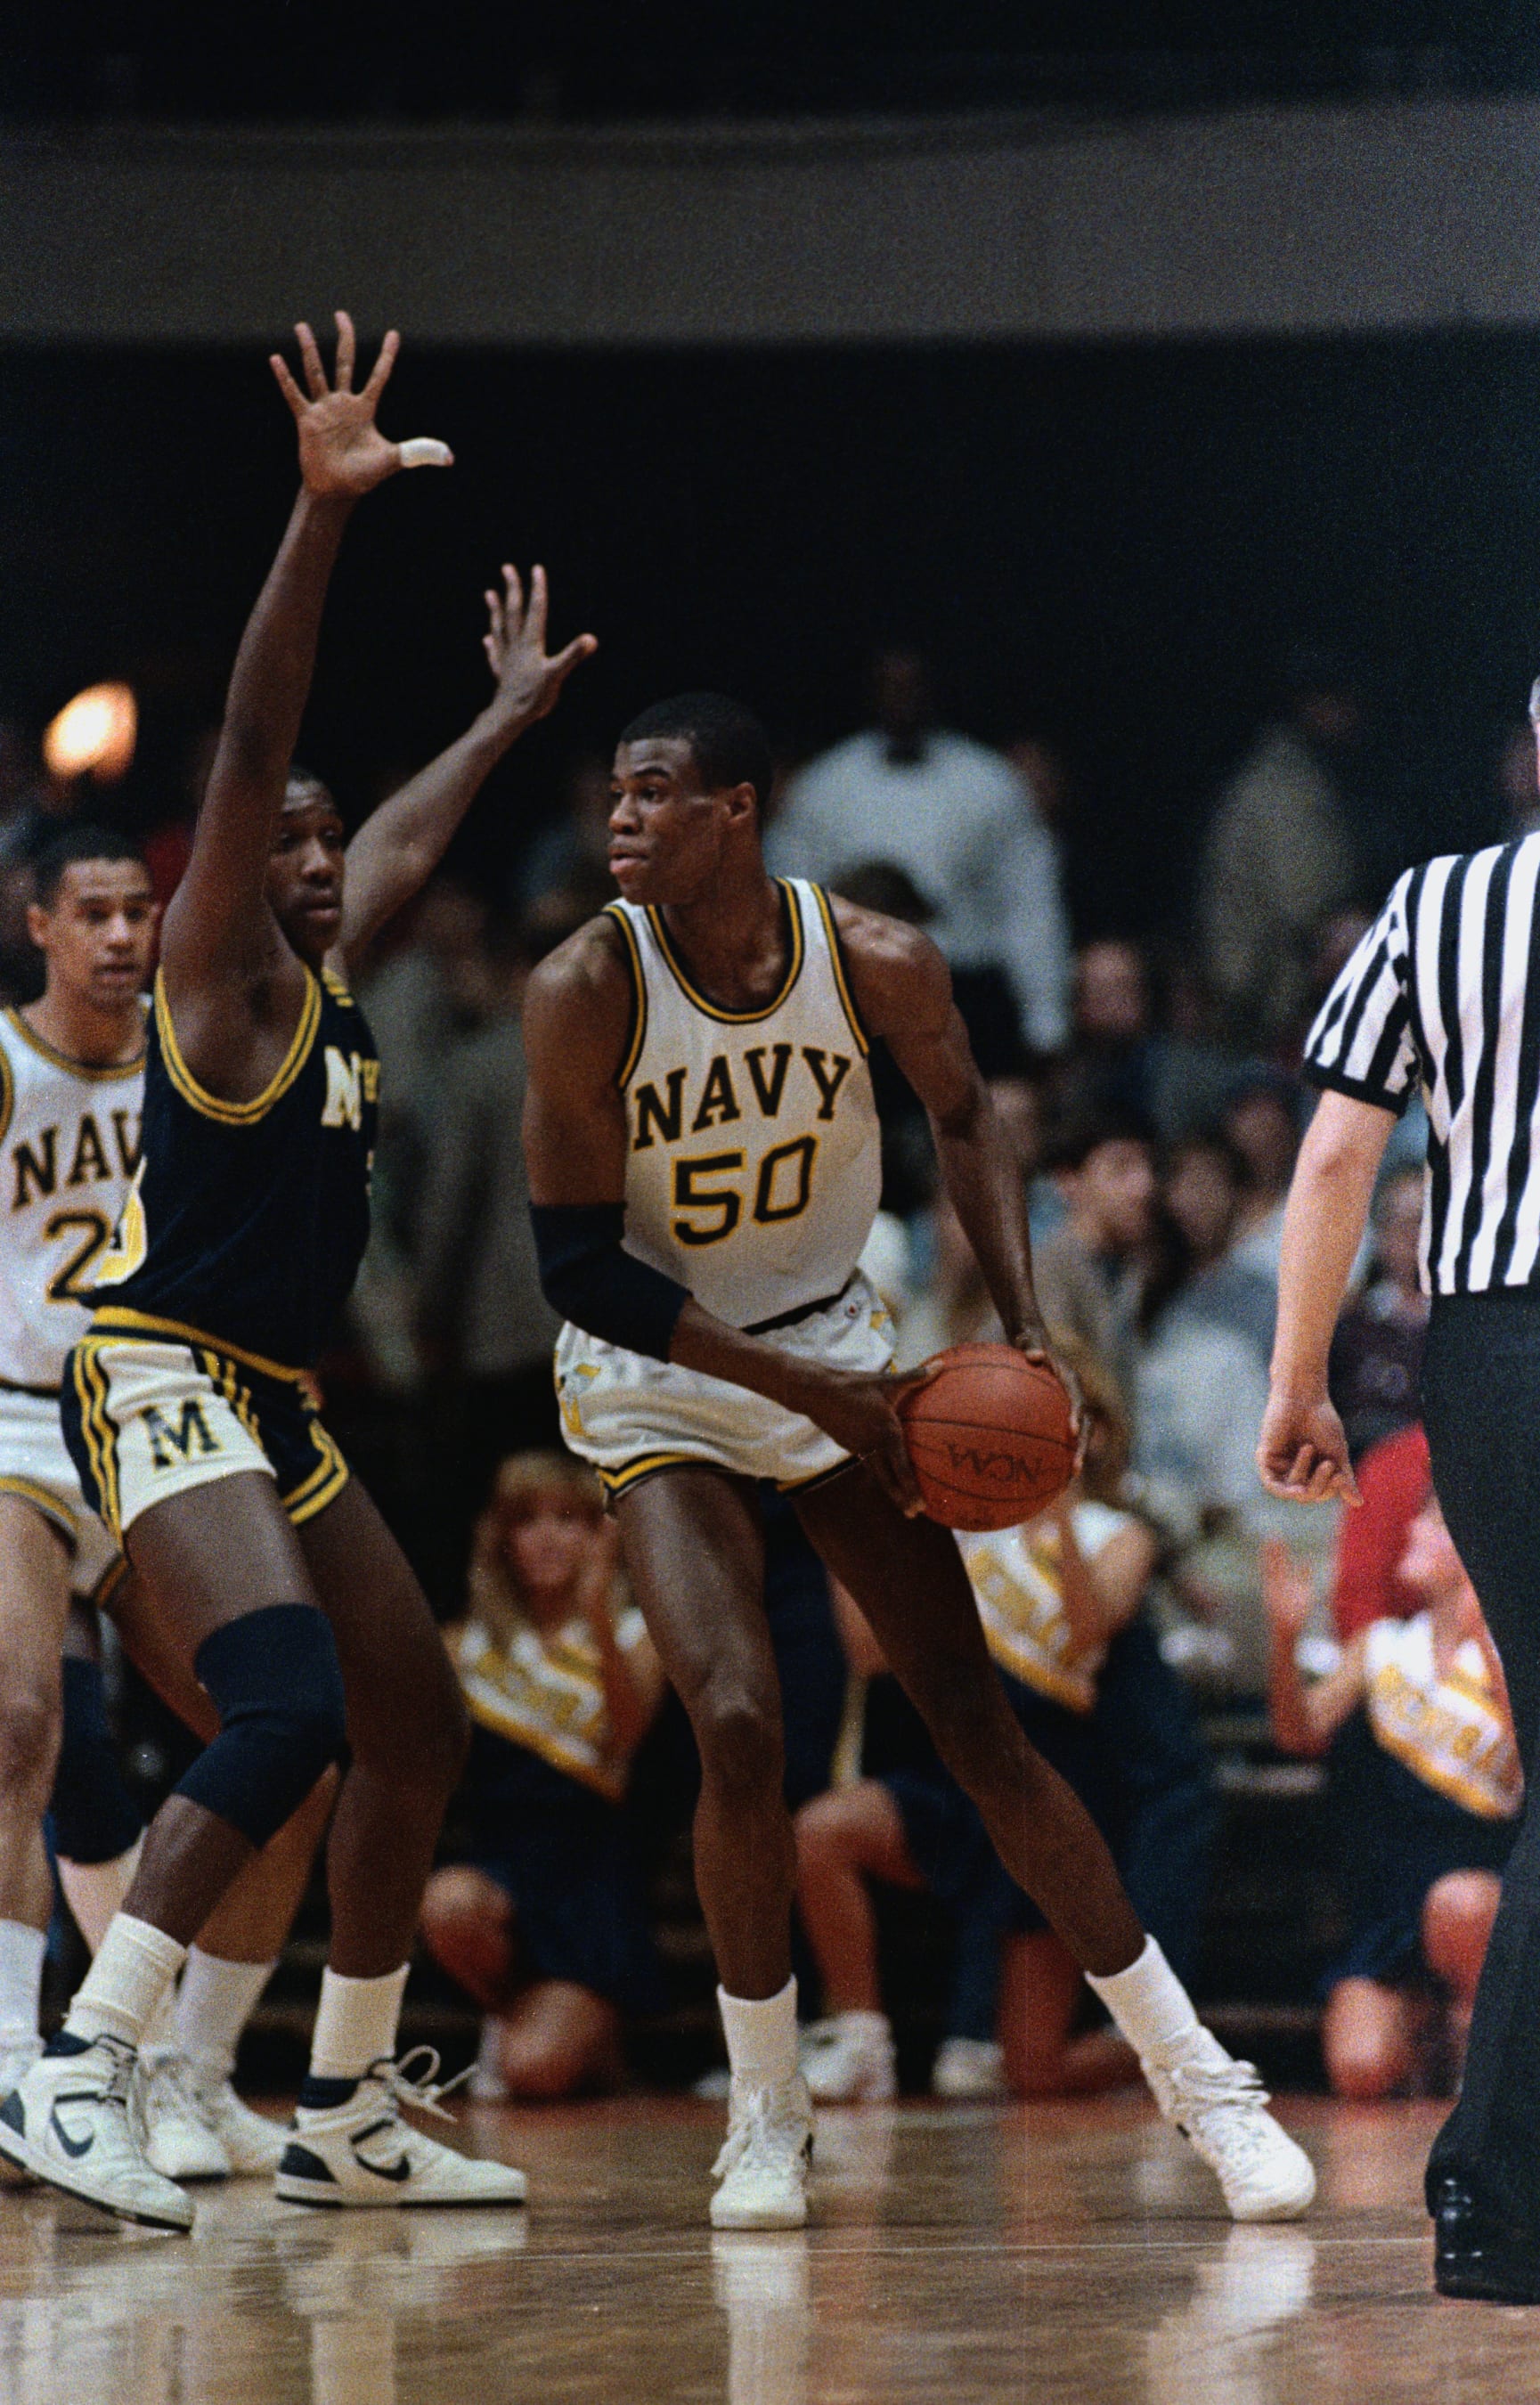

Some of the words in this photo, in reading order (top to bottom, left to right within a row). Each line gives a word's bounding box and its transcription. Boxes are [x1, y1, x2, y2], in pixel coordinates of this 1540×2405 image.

[632, 1042, 852, 1151] NAVY
[12, 1108, 143, 1213] NAV
[671, 1131, 821, 1250] 50
[138, 1397, 221, 1472] M
